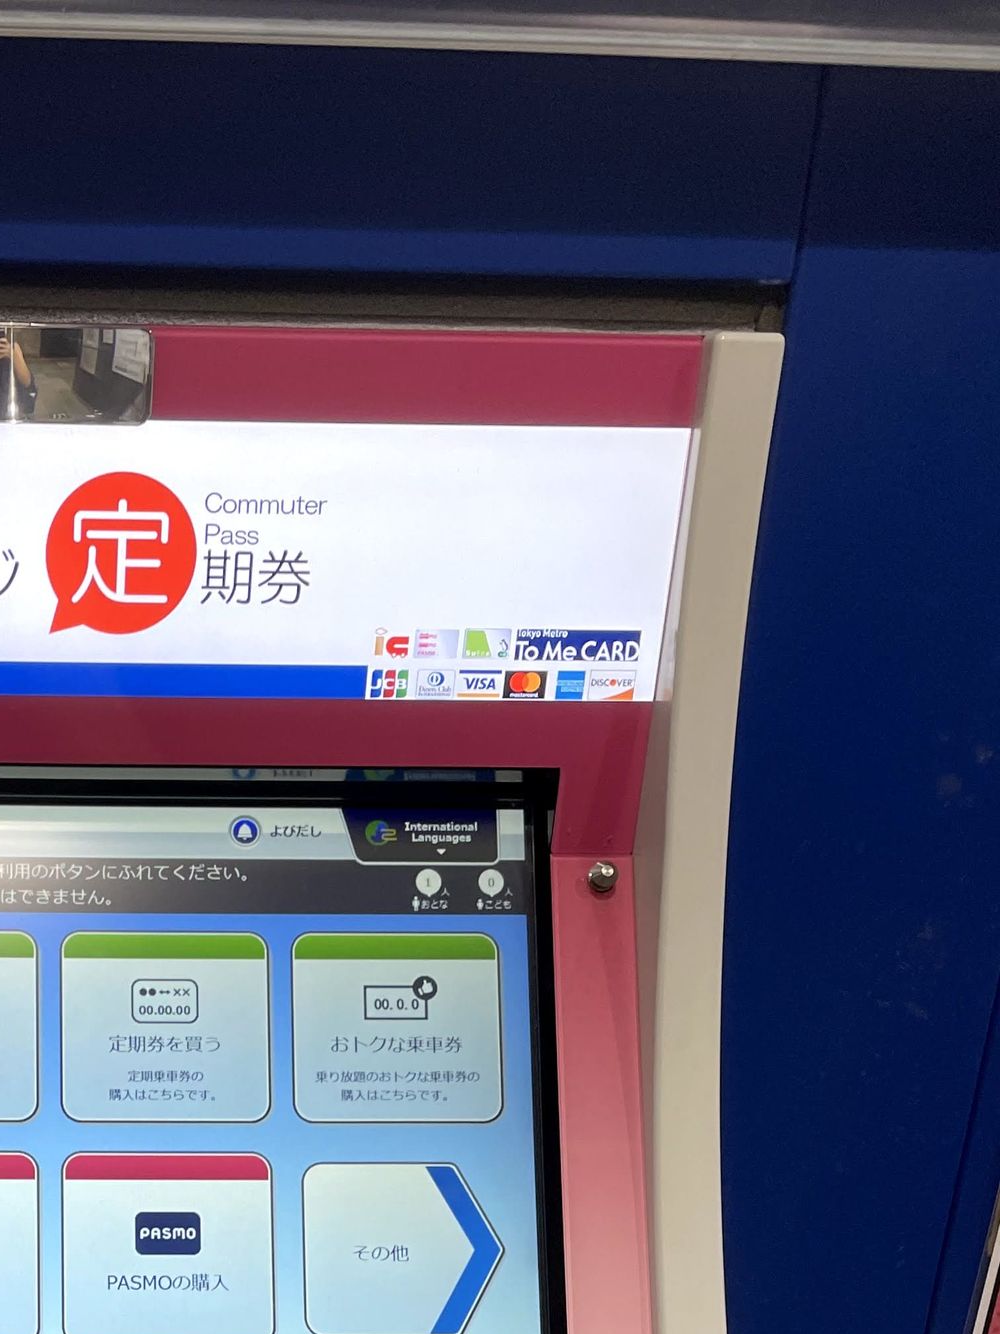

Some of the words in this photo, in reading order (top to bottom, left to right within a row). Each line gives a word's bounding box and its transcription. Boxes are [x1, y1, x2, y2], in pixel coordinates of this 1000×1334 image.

[204, 491, 328, 517] Commuter
[204, 523, 259, 547] Pass
[518, 628, 541, 640] Tokyo
[543, 628, 568, 638] Metro
[516, 640, 539, 661] To
[543, 640, 577, 661] Me
[580, 640, 641, 662] CARD
[464, 677, 496, 690] VISA
[591, 678, 635, 687] DISCOVER
[270, 824, 322, 838] よびだし
[404, 821, 478, 832] International
[412, 832, 472, 844] Languages
[425, 877, 432, 888] 1
[487, 877, 496, 888] 0
[420, 899, 449, 910] おとな
[484, 899, 512, 910] こども
[138, 1005, 192, 1016] 00.00.00
[108, 1034, 221, 1053] 定期券を買う
[331, 1035, 463, 1054] おトクな乗車券
[127, 1069, 204, 1083] 定期乗車券の
[316, 1070, 480, 1083] 乗り放題のおトクな乗車券の
[108, 1087, 217, 1102] 購入はこちらです。
[341, 1089, 449, 1102] 購入はこちらです。
[139, 1226, 197, 1241] PASMO
[353, 1244, 409, 1263] その他
[106, 1273, 229, 1292] PASMOの購入
